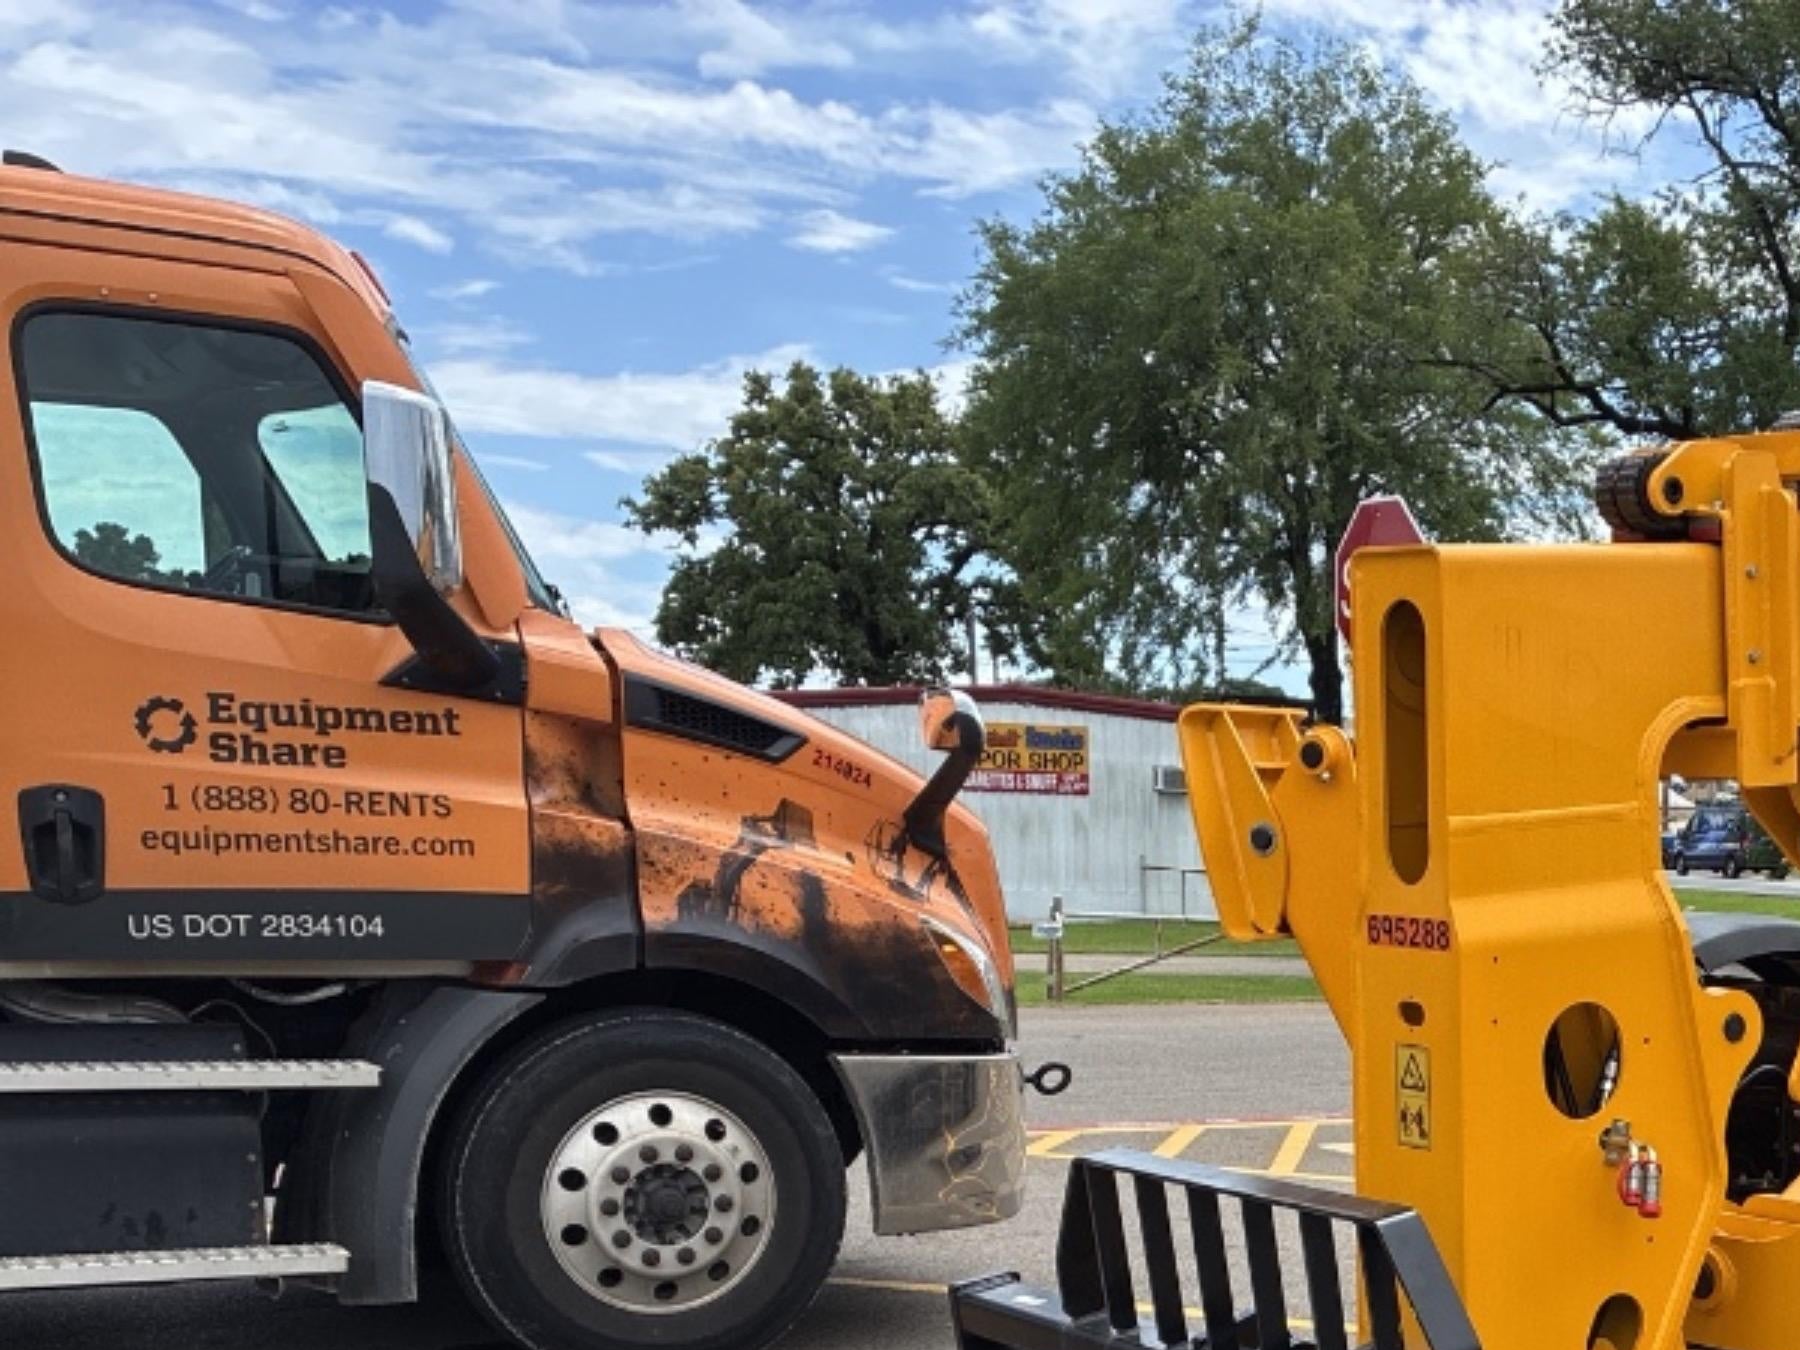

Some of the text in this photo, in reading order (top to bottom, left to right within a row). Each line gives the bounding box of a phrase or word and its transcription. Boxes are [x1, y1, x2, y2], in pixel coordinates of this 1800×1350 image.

[206, 692, 460, 737] Equipment
[208, 735, 348, 769] Share
[162, 784, 453, 818] 1 (888) 80-RENTS
[140, 825, 476, 858] equipmentshare.com
[127, 913, 385, 938] US DOT 2834104
[1367, 914, 1450, 950] 695288
